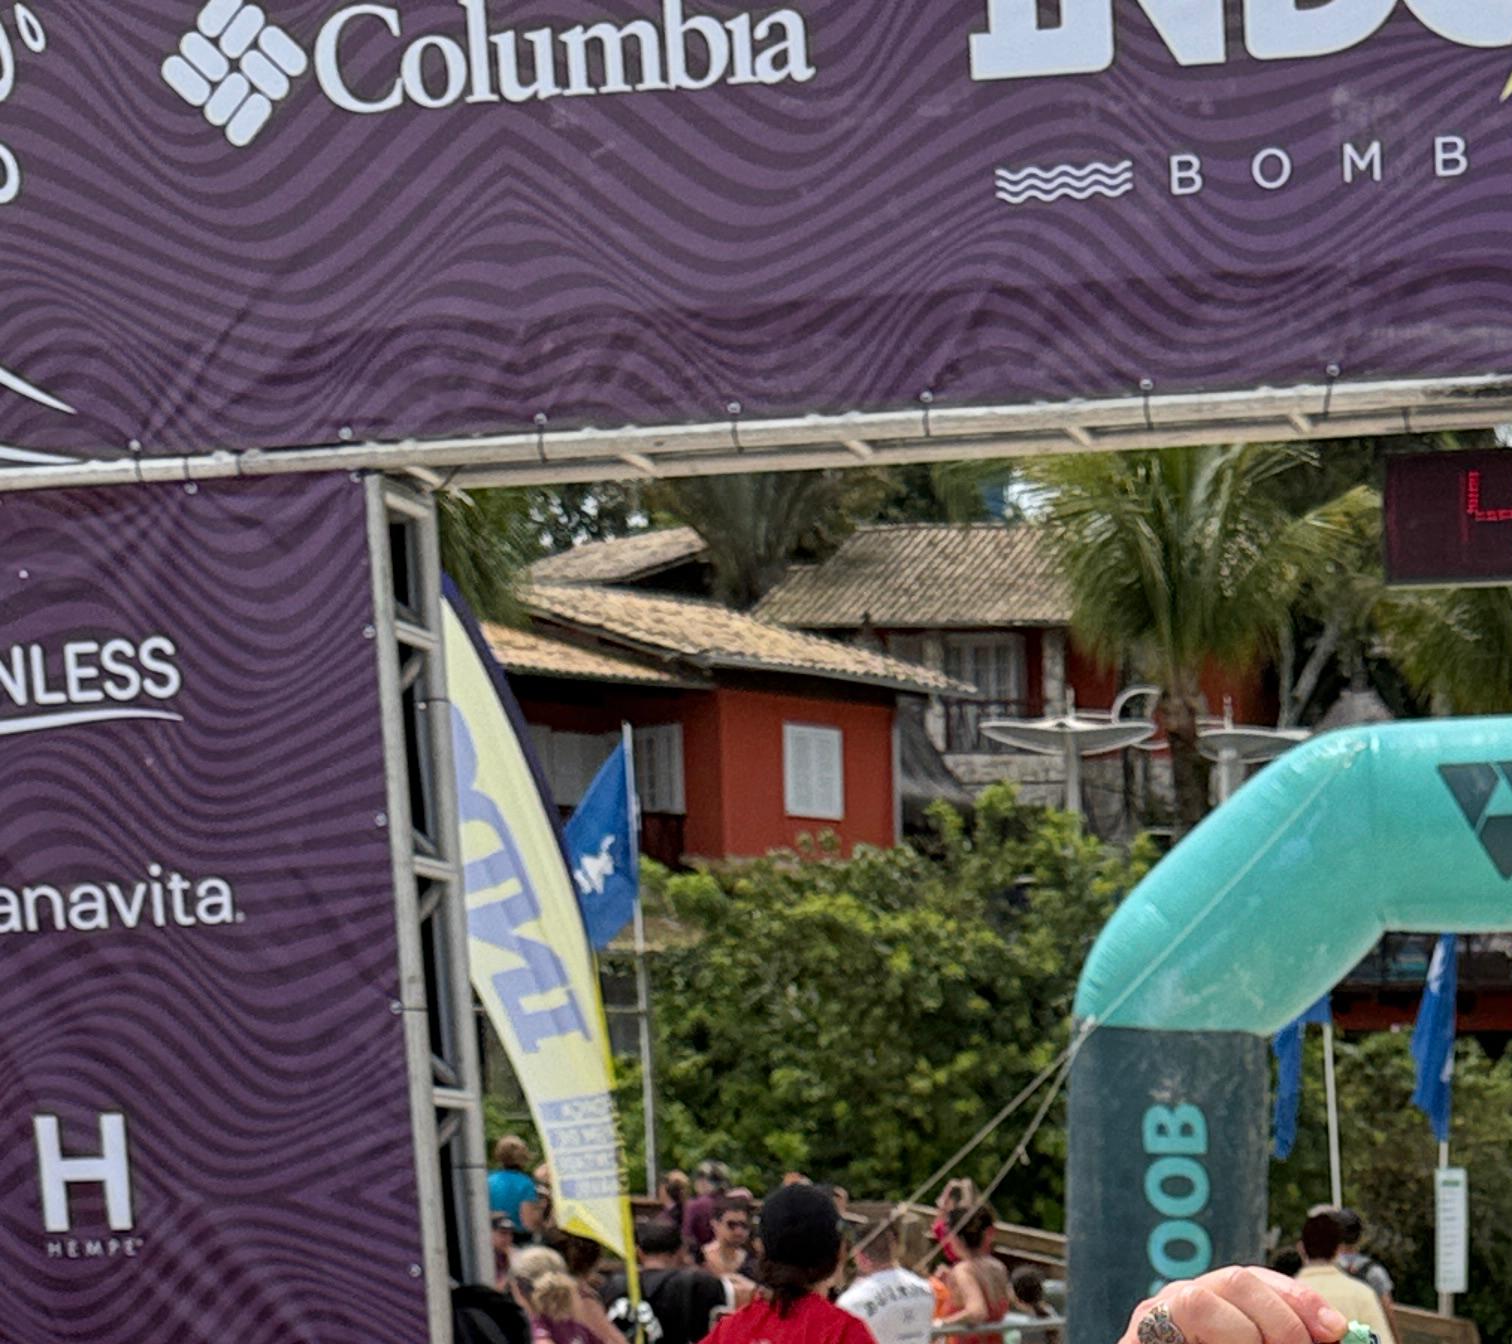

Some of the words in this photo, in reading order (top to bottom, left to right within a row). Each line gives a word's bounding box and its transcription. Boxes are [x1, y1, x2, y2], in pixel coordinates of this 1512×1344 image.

[314, 0, 816, 114] Columbia
[33, 1112, 135, 1233] H
[1142, 1102, 1212, 1296] OOB
